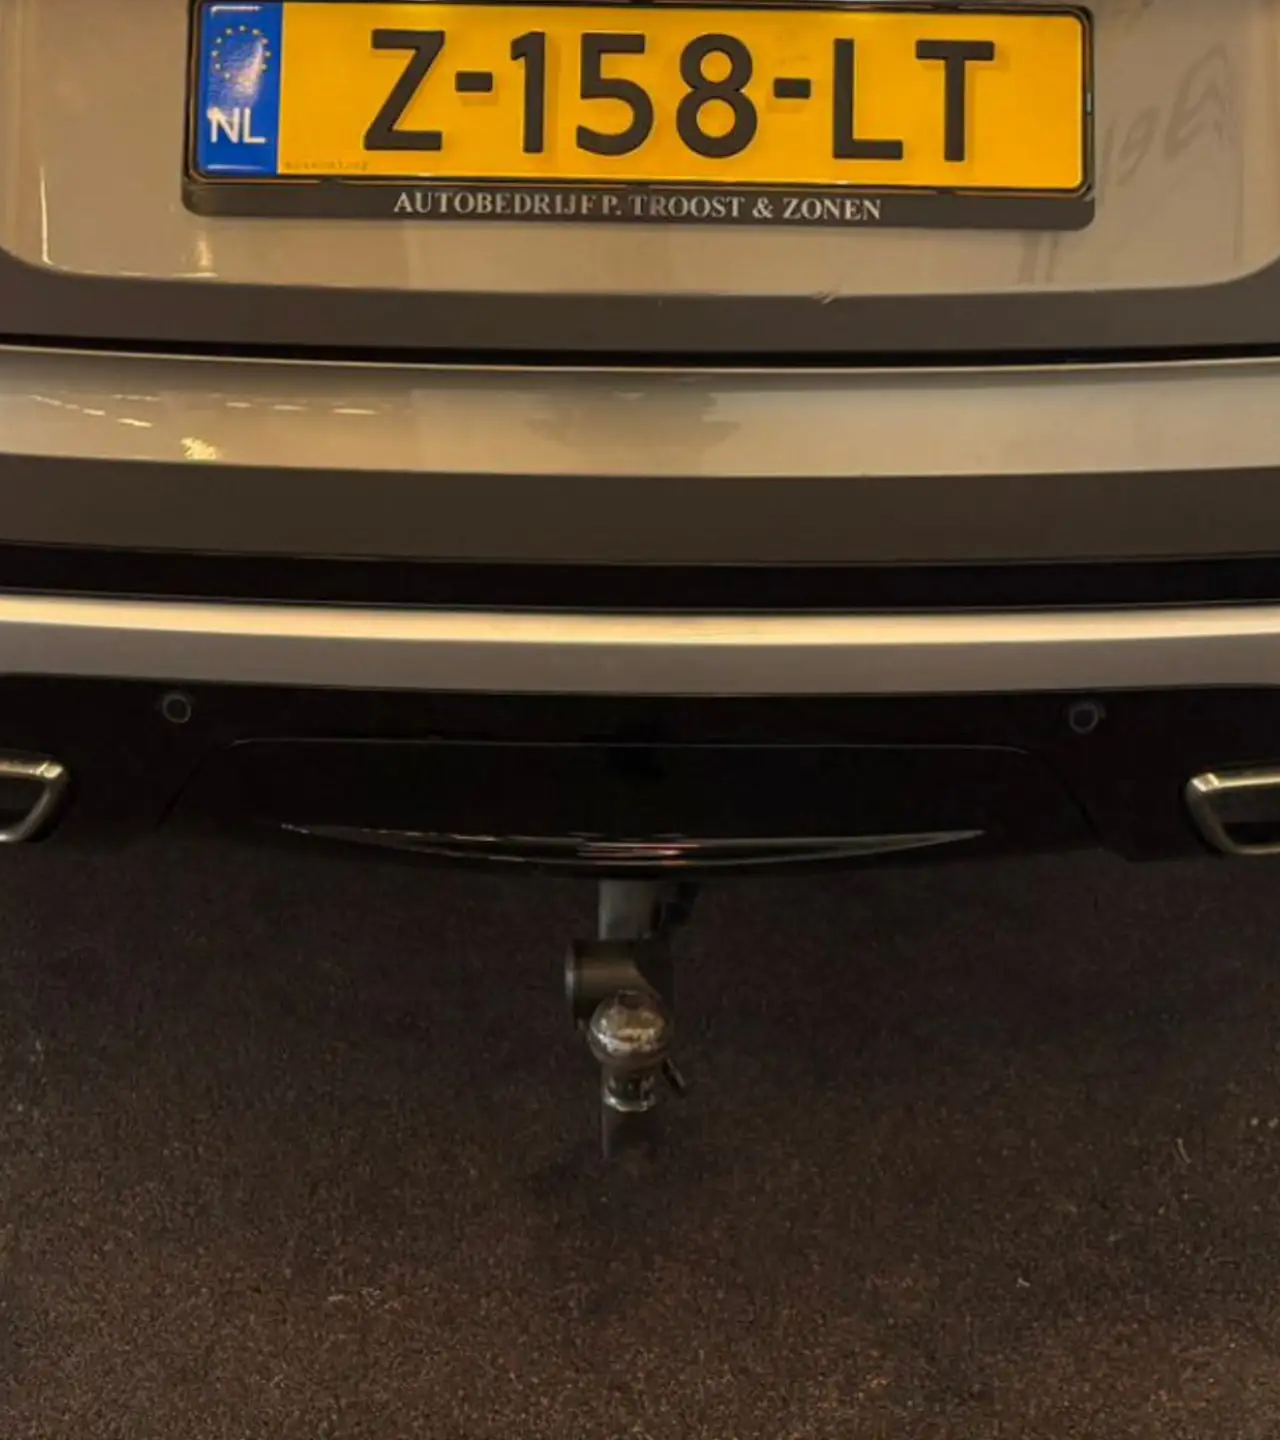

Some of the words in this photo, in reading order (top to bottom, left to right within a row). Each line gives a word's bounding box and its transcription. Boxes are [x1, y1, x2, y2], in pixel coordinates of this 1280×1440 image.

[362, 28, 997, 164] Z-158-LT
[207, 106, 267, 145] NL
[393, 191, 598, 216] AUTOBEDRIJF
[601, 194, 623, 216] P.
[627, 194, 747, 219] TROOST
[751, 196, 775, 219] &
[781, 197, 883, 221] ZONEN
